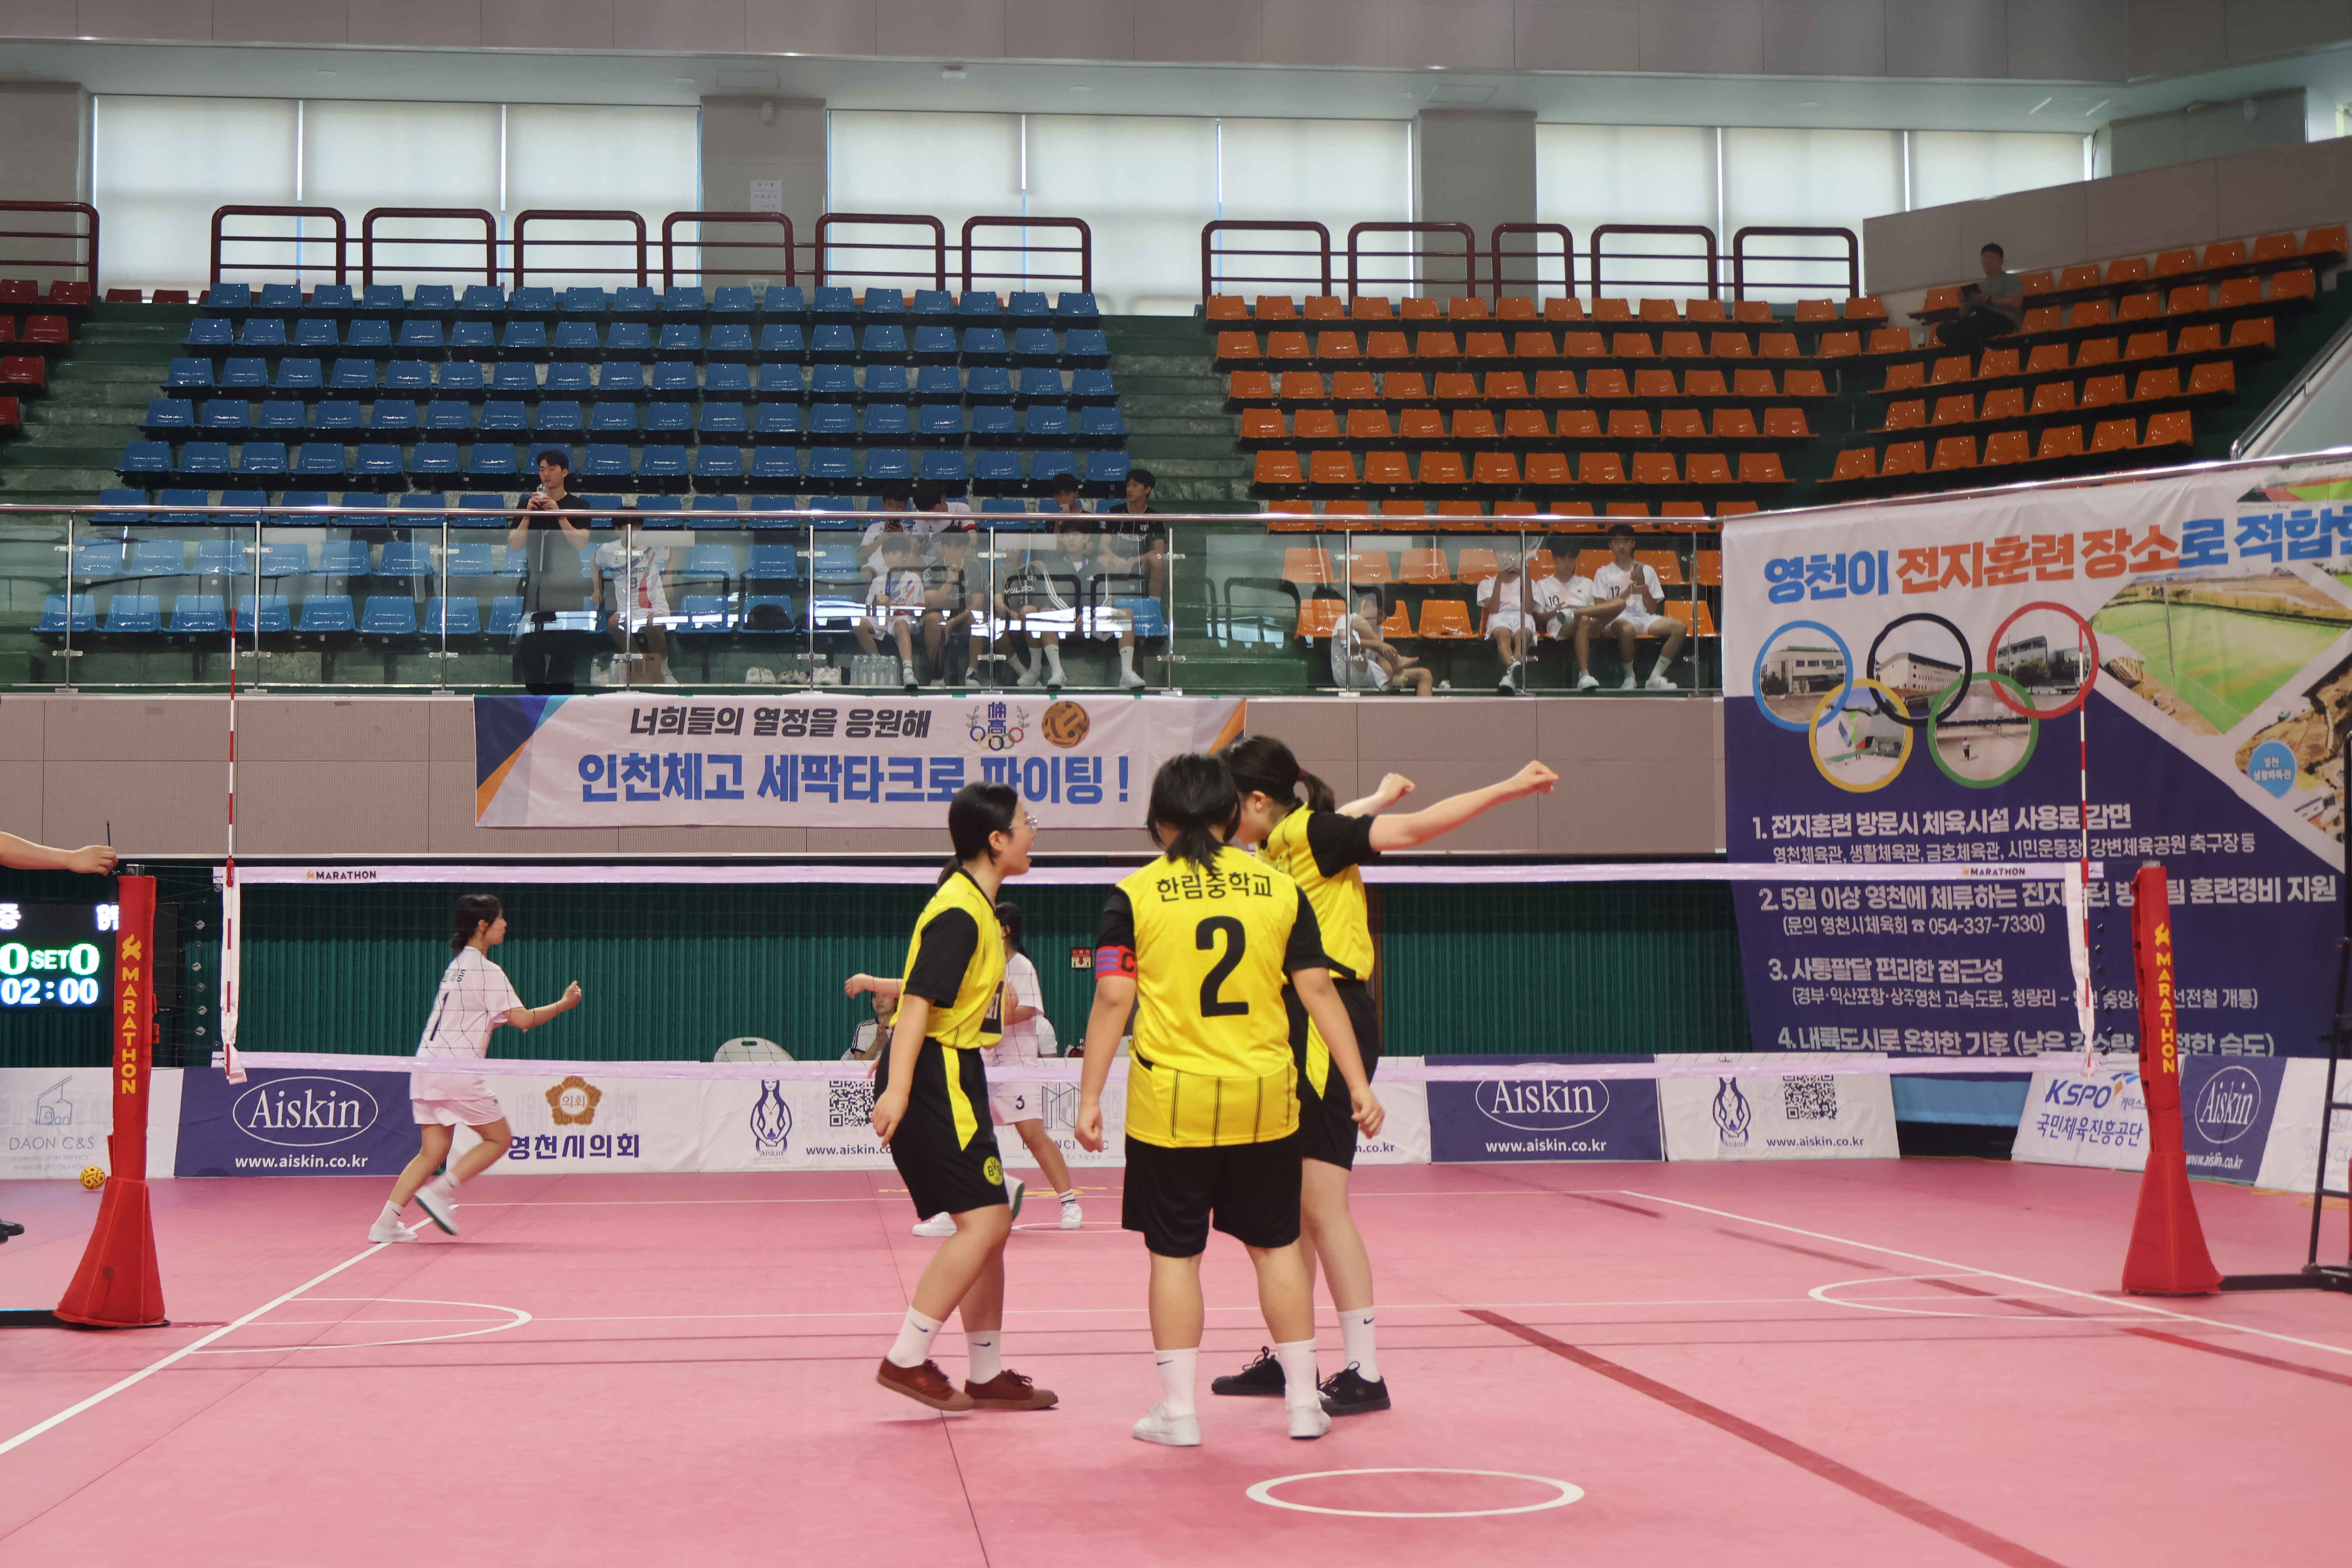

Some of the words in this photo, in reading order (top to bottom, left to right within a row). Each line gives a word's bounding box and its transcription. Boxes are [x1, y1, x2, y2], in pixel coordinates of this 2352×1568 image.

[1764, 550, 1889, 604] 영천이
[1895, 533, 2074, 594] 전지훈련
[2080, 518, 2229, 579] 장소로
[630, 707, 744, 735] 너희들의
[753, 707, 838, 737] 열정을
[845, 709, 931, 738] 응원해
[579, 753, 744, 802] 인천체고
[757, 754, 964, 803] 세팍타크로
[981, 757, 1103, 804] 파이팅
[1753, 817, 1767, 839] 1.
[1771, 813, 1852, 839] 전지훈련
[1856, 811, 1918, 836] 방문시
[1923, 807, 2009, 835] 체육시설
[2015, 805, 2080, 831] 사용료
[2085, 803, 2131, 830] 감면
[1773, 845, 1847, 864] 영천체육관,
[1850, 843, 1924, 863] 생활체육관,
[1927, 841, 2004, 862] 금호체육관,
[2091, 835, 2186, 858] 강변체육공원
[316, 871, 376, 880] MARATHON
[1971, 867, 2025, 876] MARATHON
[1156, 872, 1272, 902] 한림중학교
[1822, 886, 1861, 910] 이상
[1866, 885, 1926, 910] 영천에
[1931, 884, 2017, 910] 체류하는
[2190, 877, 2280, 904] 훈련경비
[2287, 875, 2336, 902] 지원
[1783, 916, 1818, 936] (문의
[1820, 915, 1907, 935] 영천시체육회
[1929, 913, 2045, 935] 054-337-7330)
[0, 943, 29, 975] 0
[31, 949, 70, 969] SET
[69, 943, 100, 976] 0
[1196, 915, 1249, 1018] 2
[1768, 958, 1788, 981] 3.
[1792, 957, 1872, 981] 사통팔달
[1876, 957, 1934, 983] 편리한
[1938, 958, 2003, 984] 접근성
[1, 977, 98, 1005] 02:00
[1945, 989, 2008, 1009] 고속도로,
[2012, 988, 2056, 1008] 청량리
[2222, 988, 2258, 1009] 개통)
[2156, 953, 2175, 1073] MARATHON
[122, 967, 139, 1094] MARATHON
[1798, 1027, 1901, 1052] 내륙도시로
[1904, 1028, 1961, 1056] 온화한
[1965, 1031, 2010, 1056] 기후
[248, 1089, 362, 1129] Aiskin
[561, 1095, 585, 1107] 의회
[1491, 1080, 1596, 1113] Aiskin
[2045, 1079, 2111, 1109] KSPO
[2200, 1081, 2253, 1125] Aiskin
[9, 1137, 56, 1150] DAON
[63, 1137, 94, 1149] C&S
[1766, 1136, 1864, 1146] www.aiskin.co.kr
[2037, 1113, 2143, 1146] 국민체육진흥공단
[508, 1133, 639, 1160] 영천시의회
[1485, 1138, 1606, 1152] www.aiskin.co.kr
[235, 1154, 368, 1169] www.aiskin.co.kr
